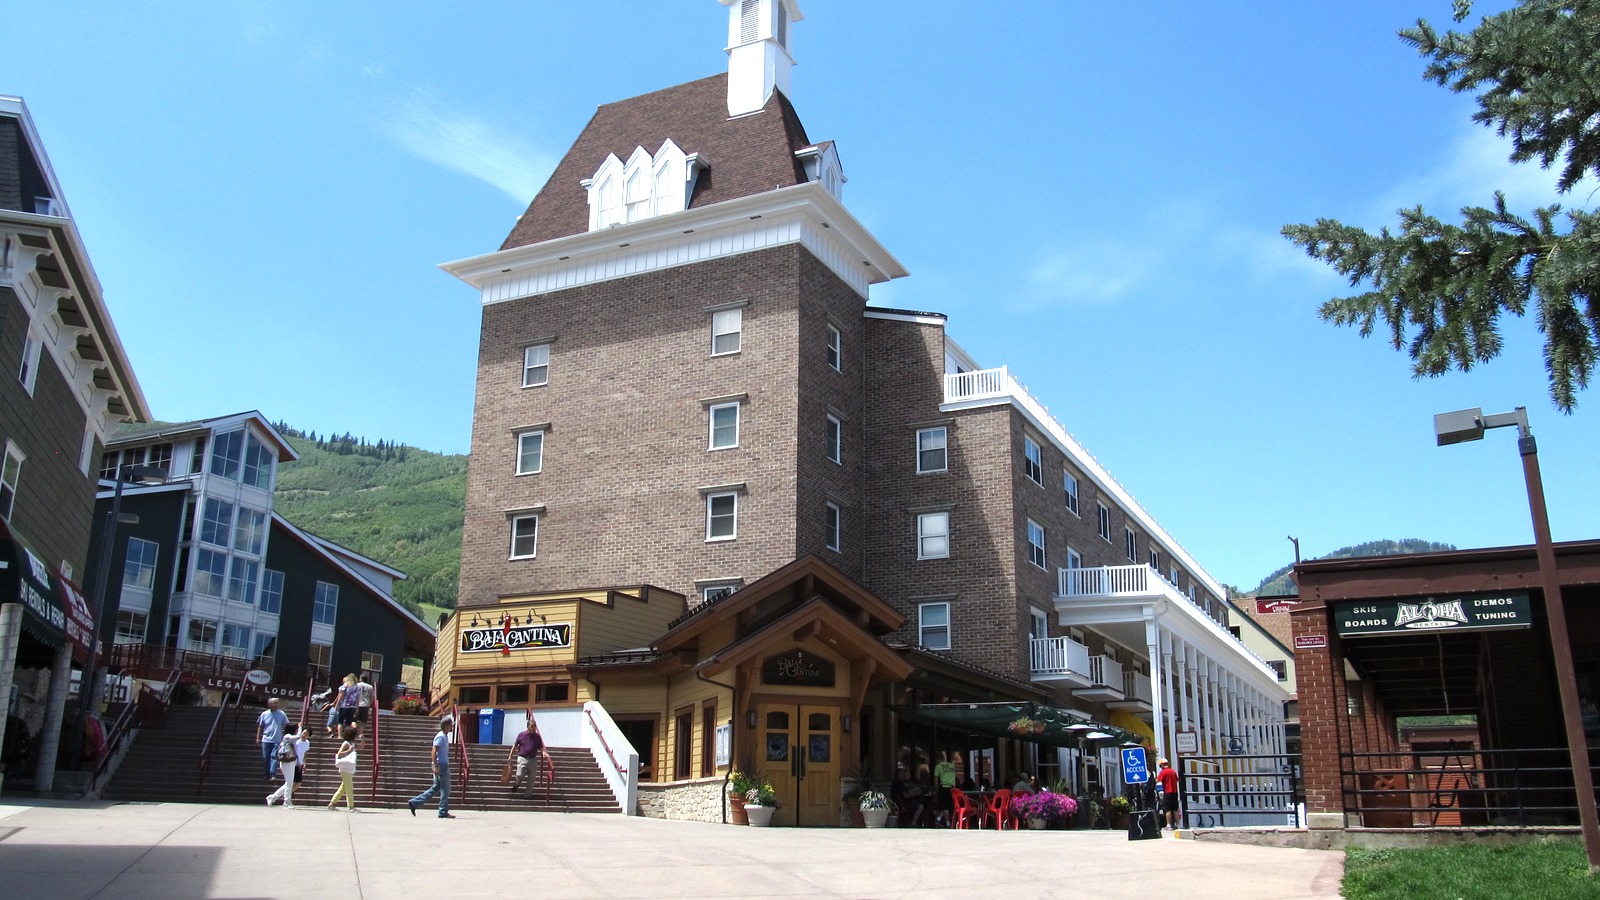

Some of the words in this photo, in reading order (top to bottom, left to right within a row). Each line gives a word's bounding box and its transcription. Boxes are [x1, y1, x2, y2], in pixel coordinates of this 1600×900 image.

[1474, 598, 1513, 607] DEMOS
[1353, 606, 1377, 614] SKIS
[1395, 599, 1468, 626] ALOHA
[1475, 611, 1516, 620] TUNING
[1345, 618, 1388, 627] BOARDS
[470, 630, 506, 650] BAJA
[505, 628, 563, 648] CANTINA
[264, 686, 303, 698] LODGE
